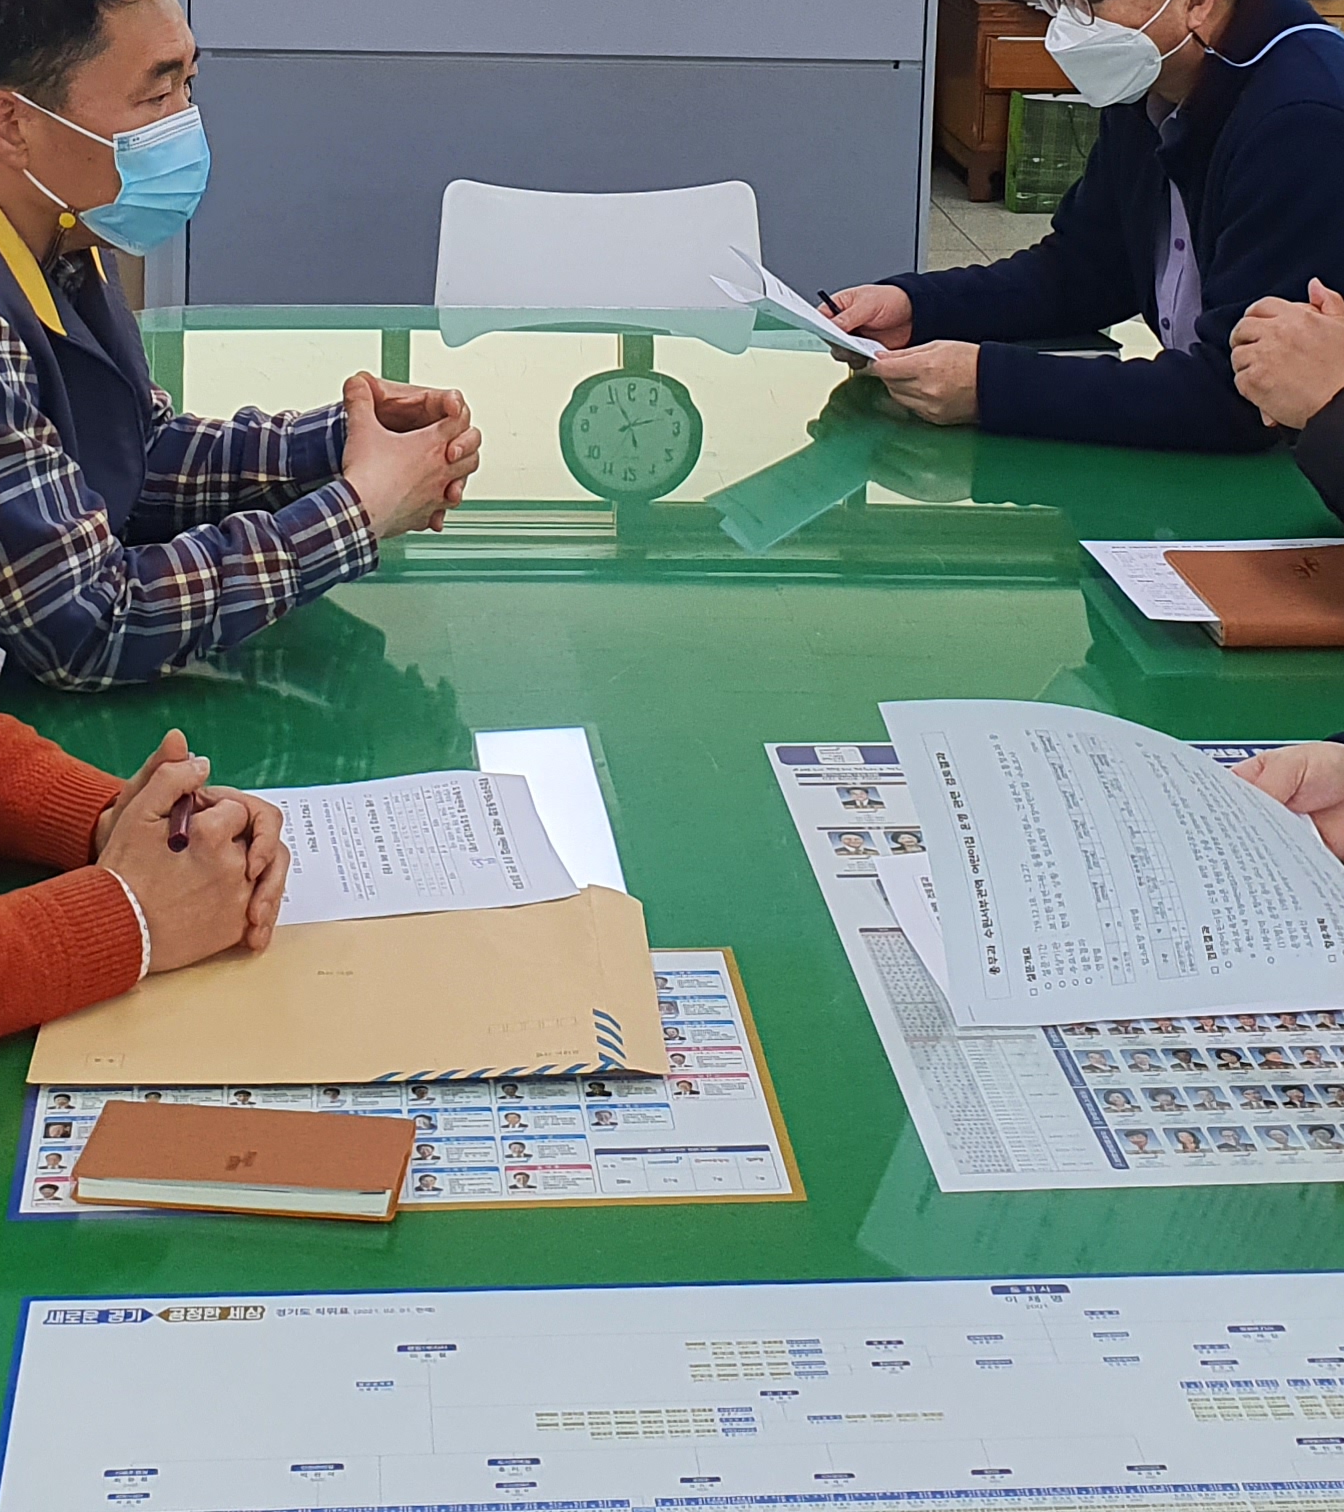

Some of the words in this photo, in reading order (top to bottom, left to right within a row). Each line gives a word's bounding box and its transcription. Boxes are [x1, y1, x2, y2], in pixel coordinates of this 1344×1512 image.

[937, 752, 954, 786] 검토결과
[951, 791, 962, 808] 관련
[958, 813, 969, 831] 운영
[965, 836, 980, 874] 어린이집
[976, 879, 994, 938] 수원서부권역
[1202, 925, 1216, 960] 검토결과
[987, 945, 999, 975] 총무과
[1023, 947, 1036, 982] 설문개요
[46, 1310, 100, 1324] 새로운
[108, 1309, 143, 1323] 경기
[168, 1307, 222, 1321] 공정한
[230, 1306, 264, 1320] 세상
[275, 1307, 312, 1317] 경기도
